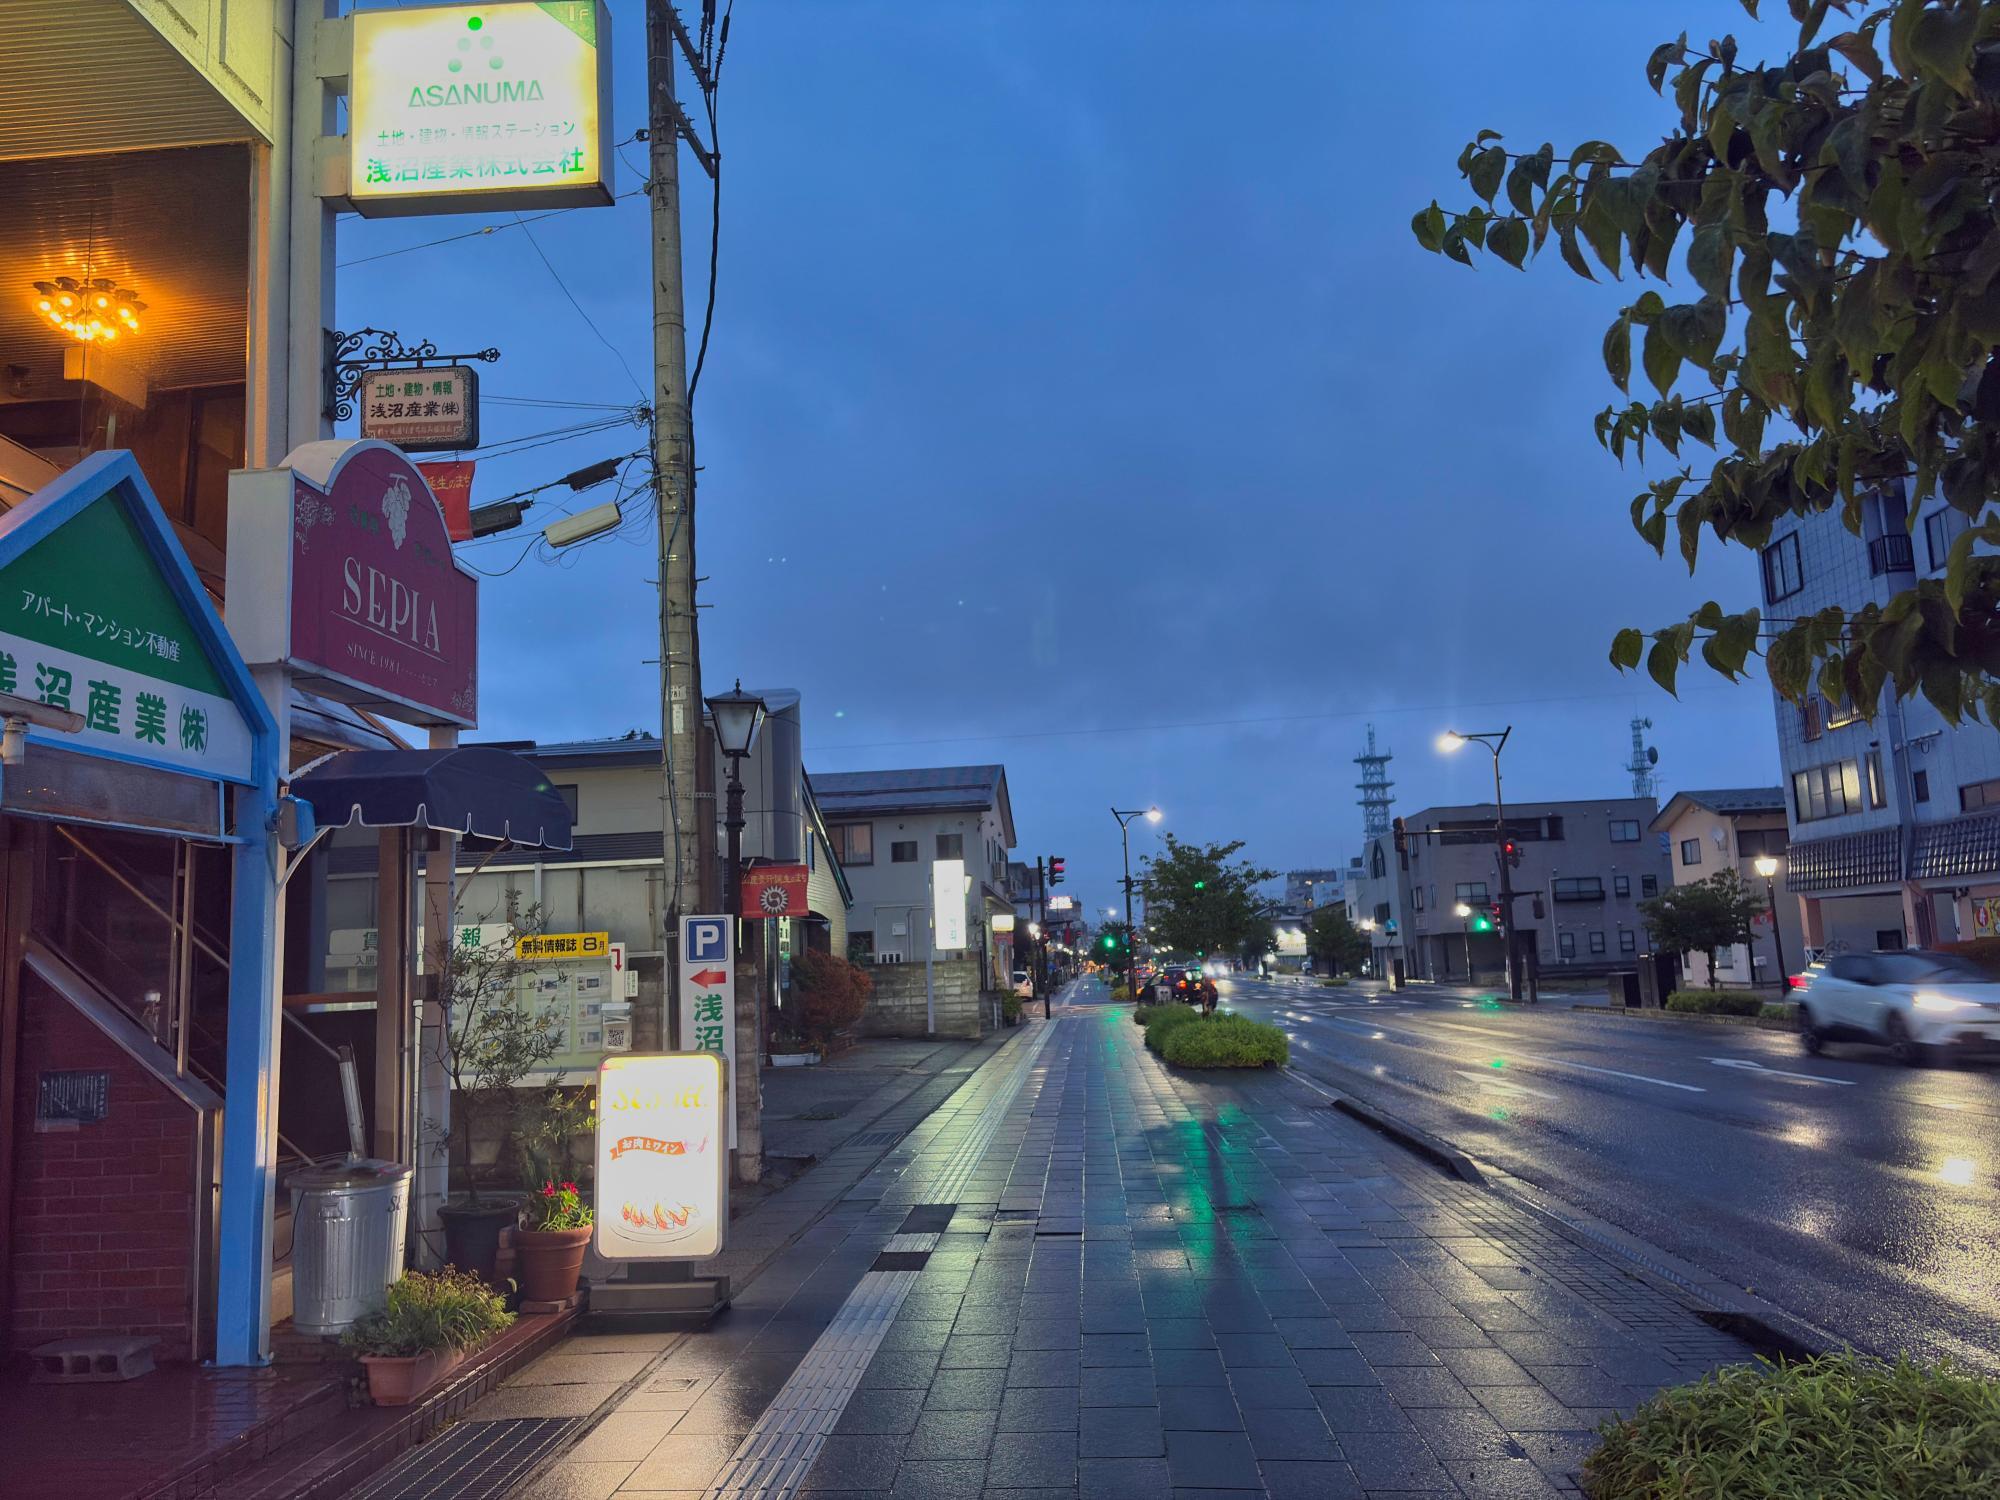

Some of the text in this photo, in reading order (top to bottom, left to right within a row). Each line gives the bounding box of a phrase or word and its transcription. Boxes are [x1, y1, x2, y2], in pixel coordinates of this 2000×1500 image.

[408, 79, 544, 108] ASANUMA
[366, 147, 584, 183] 浅沼産業株式会社
[375, 381, 453, 398] 土地・建物・情報
[343, 556, 441, 654] SEPIA
[22, 590, 180, 662] アパート・マンション不動産
[461, 927, 481, 948] 報
[521, 939, 577, 954] 無料情報誌
[696, 925, 719, 957] P
[693, 994, 724, 1051] 浅沼
